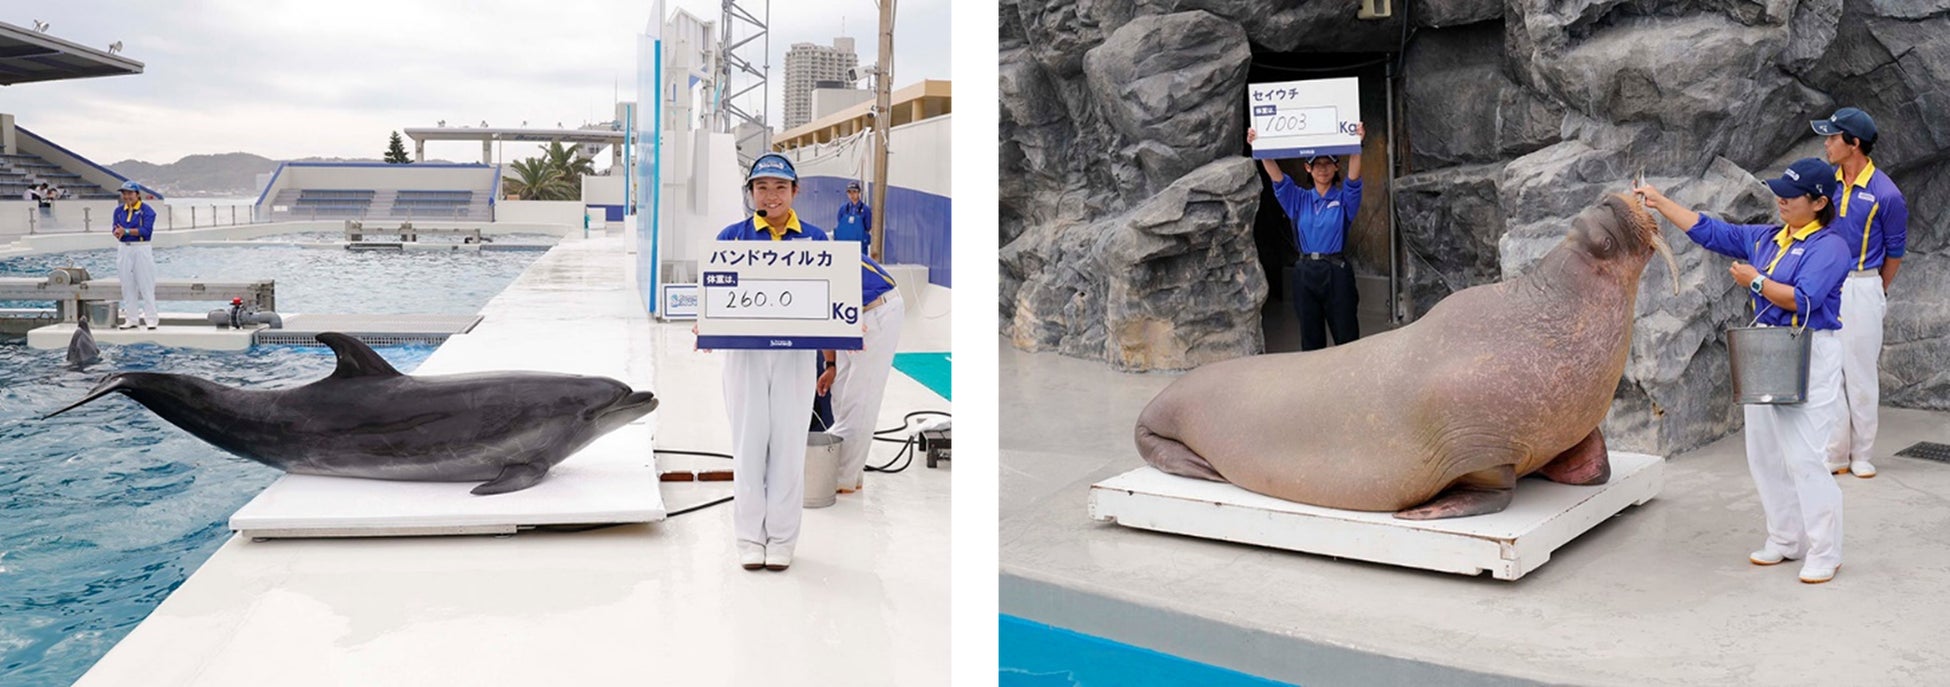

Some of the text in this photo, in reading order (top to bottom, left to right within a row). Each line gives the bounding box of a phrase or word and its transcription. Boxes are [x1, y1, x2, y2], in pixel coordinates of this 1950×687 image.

[1253, 88, 1299, 101] セイウチ
[1265, 113, 1307, 132] 1003
[1340, 121, 1357, 136] Kg
[710, 249, 833, 267] バンドウイルカ
[726, 290, 793, 309] 260.0
[832, 302, 859, 325] Kg
